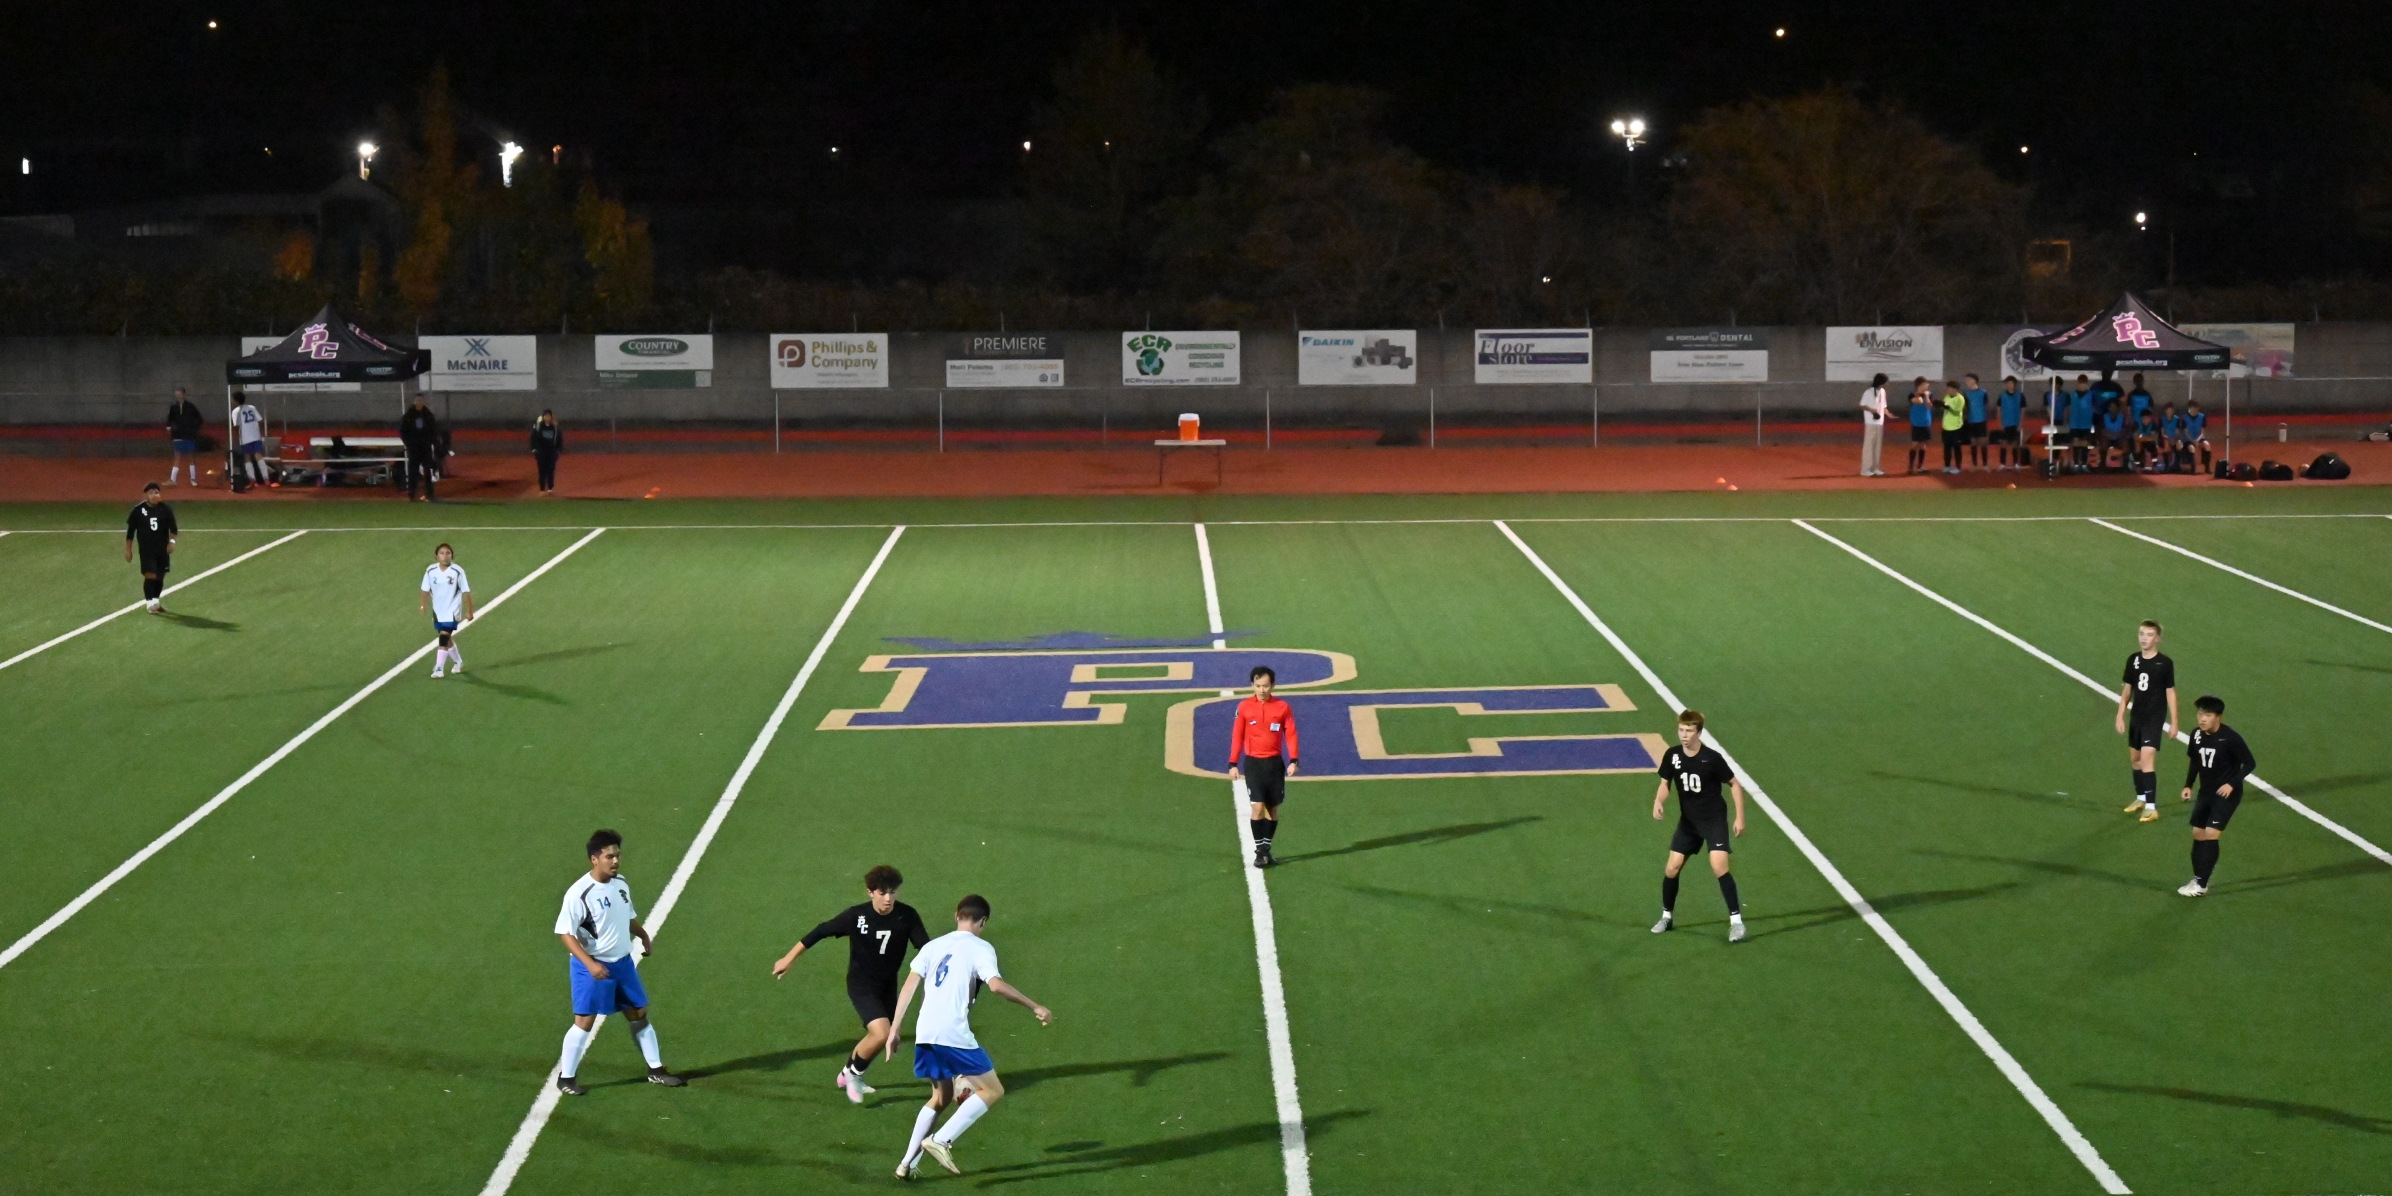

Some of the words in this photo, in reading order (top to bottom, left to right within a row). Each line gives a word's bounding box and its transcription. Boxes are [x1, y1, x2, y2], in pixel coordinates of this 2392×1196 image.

[2113, 318, 2160, 348] PC
[298, 330, 340, 359] PC
[628, 341, 680, 351] COUNTRY
[812, 341, 865, 356] Phillips
[866, 340, 878, 353] &
[974, 337, 1047, 350] PREMIERE
[1127, 335, 1172, 352] ECR
[1480, 339, 1535, 354] Floor
[1860, 339, 1912, 348] ENVISION
[447, 360, 508, 371] McNAIRE
[811, 355, 879, 370] Company
[242, 410, 255, 423] 25
[149, 517, 159, 531] 5
[2137, 672, 2149, 691] 8
[2198, 747, 2216, 768] 17
[1680, 772, 1702, 793] 10
[596, 896, 612, 910] 14
[875, 930, 892, 955] 7
[934, 954, 953, 988] 6
